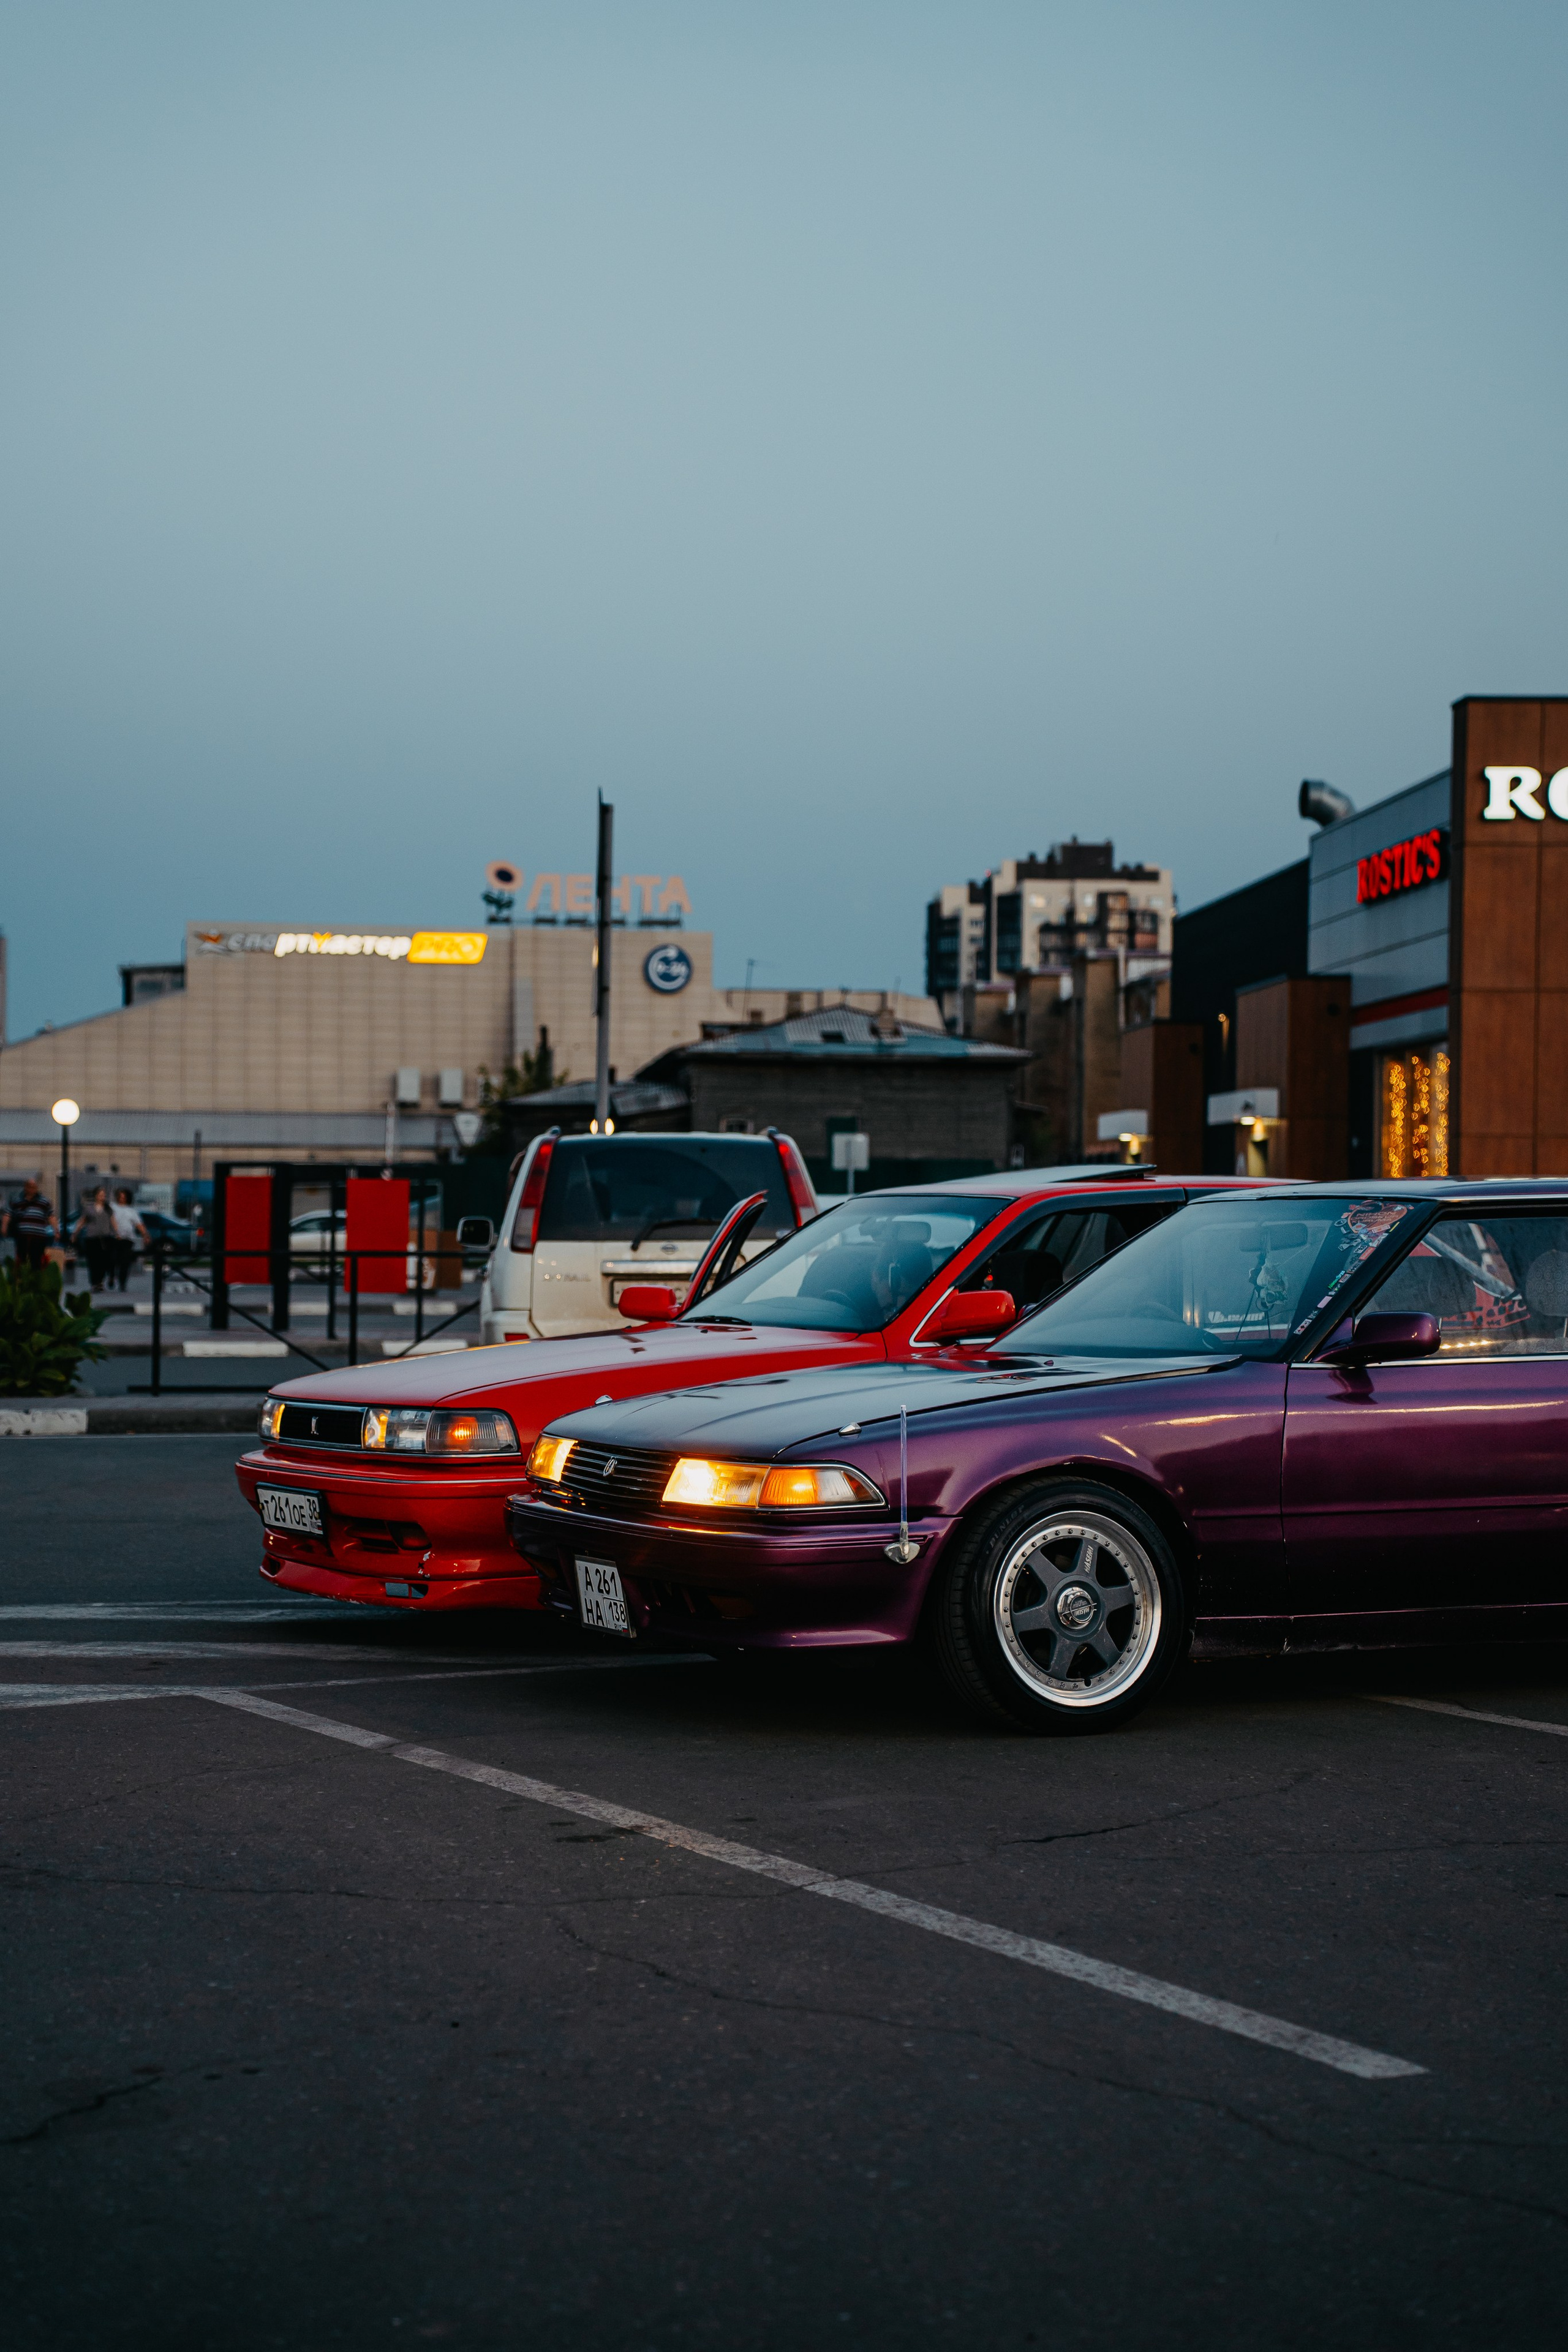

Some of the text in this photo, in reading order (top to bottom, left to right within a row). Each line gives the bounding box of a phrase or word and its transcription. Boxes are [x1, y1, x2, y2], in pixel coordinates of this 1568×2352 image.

[1356, 829, 1441, 904] ROSTIC'S
[526, 873, 693, 913] ЛЕНТА
[307, 1498, 319, 1520] 38
[989, 1504, 1025, 1548] DUNLOP
[1084, 1545, 1094, 1574] HASEMI
[595, 1568, 618, 1597] 261
[609, 1600, 626, 1623] 138
[1074, 1607, 1090, 1616] HASEMI
